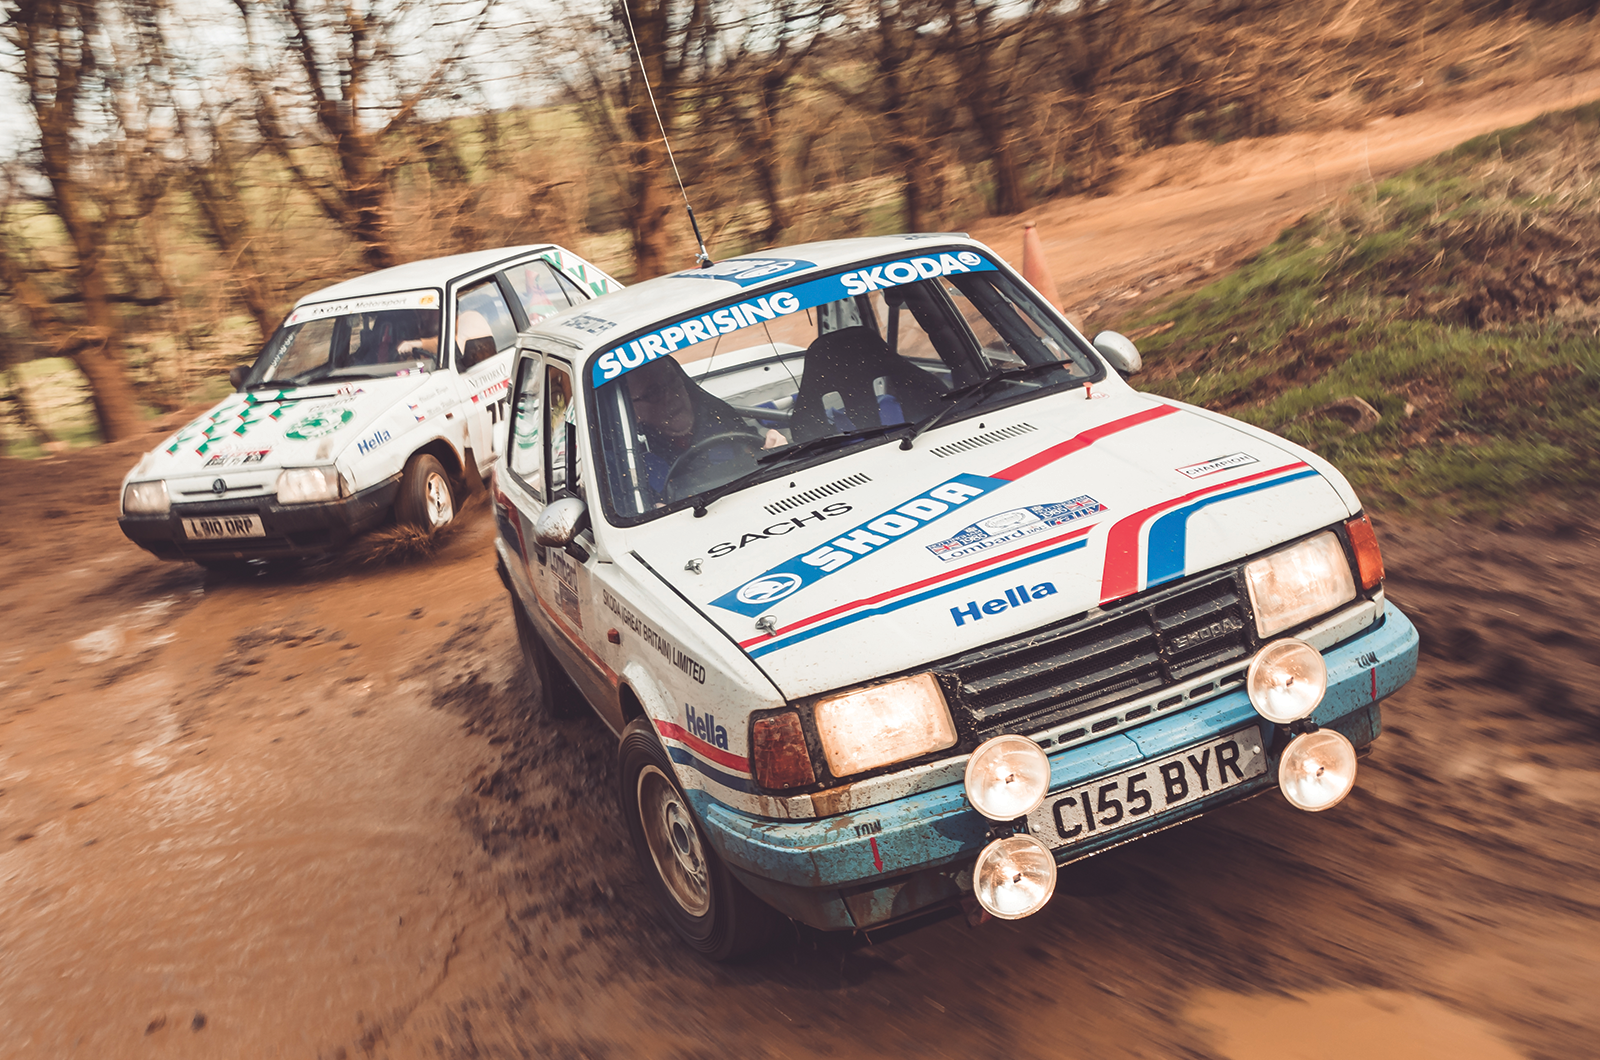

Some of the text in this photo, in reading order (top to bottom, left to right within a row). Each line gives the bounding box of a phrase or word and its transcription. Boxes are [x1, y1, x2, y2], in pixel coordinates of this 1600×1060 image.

[597, 253, 971, 381] SURPRISING SKODA
[357, 429, 392, 456] Hella
[1185, 455, 1251, 475] CHAMPION
[707, 502, 853, 559] SACHS
[937, 529, 1025, 562] Lombard
[949, 581, 1058, 627] Hella
[602, 588, 621, 616] SKODA
[622, 607, 643, 634] (GREAT
[643, 624, 672, 665] BRITAIN)
[672, 647, 706, 685] LIMITED
[685, 703, 729, 750] Hella
[1052, 740, 1244, 839] C155 BYR
[853, 819, 882, 837] TOW
